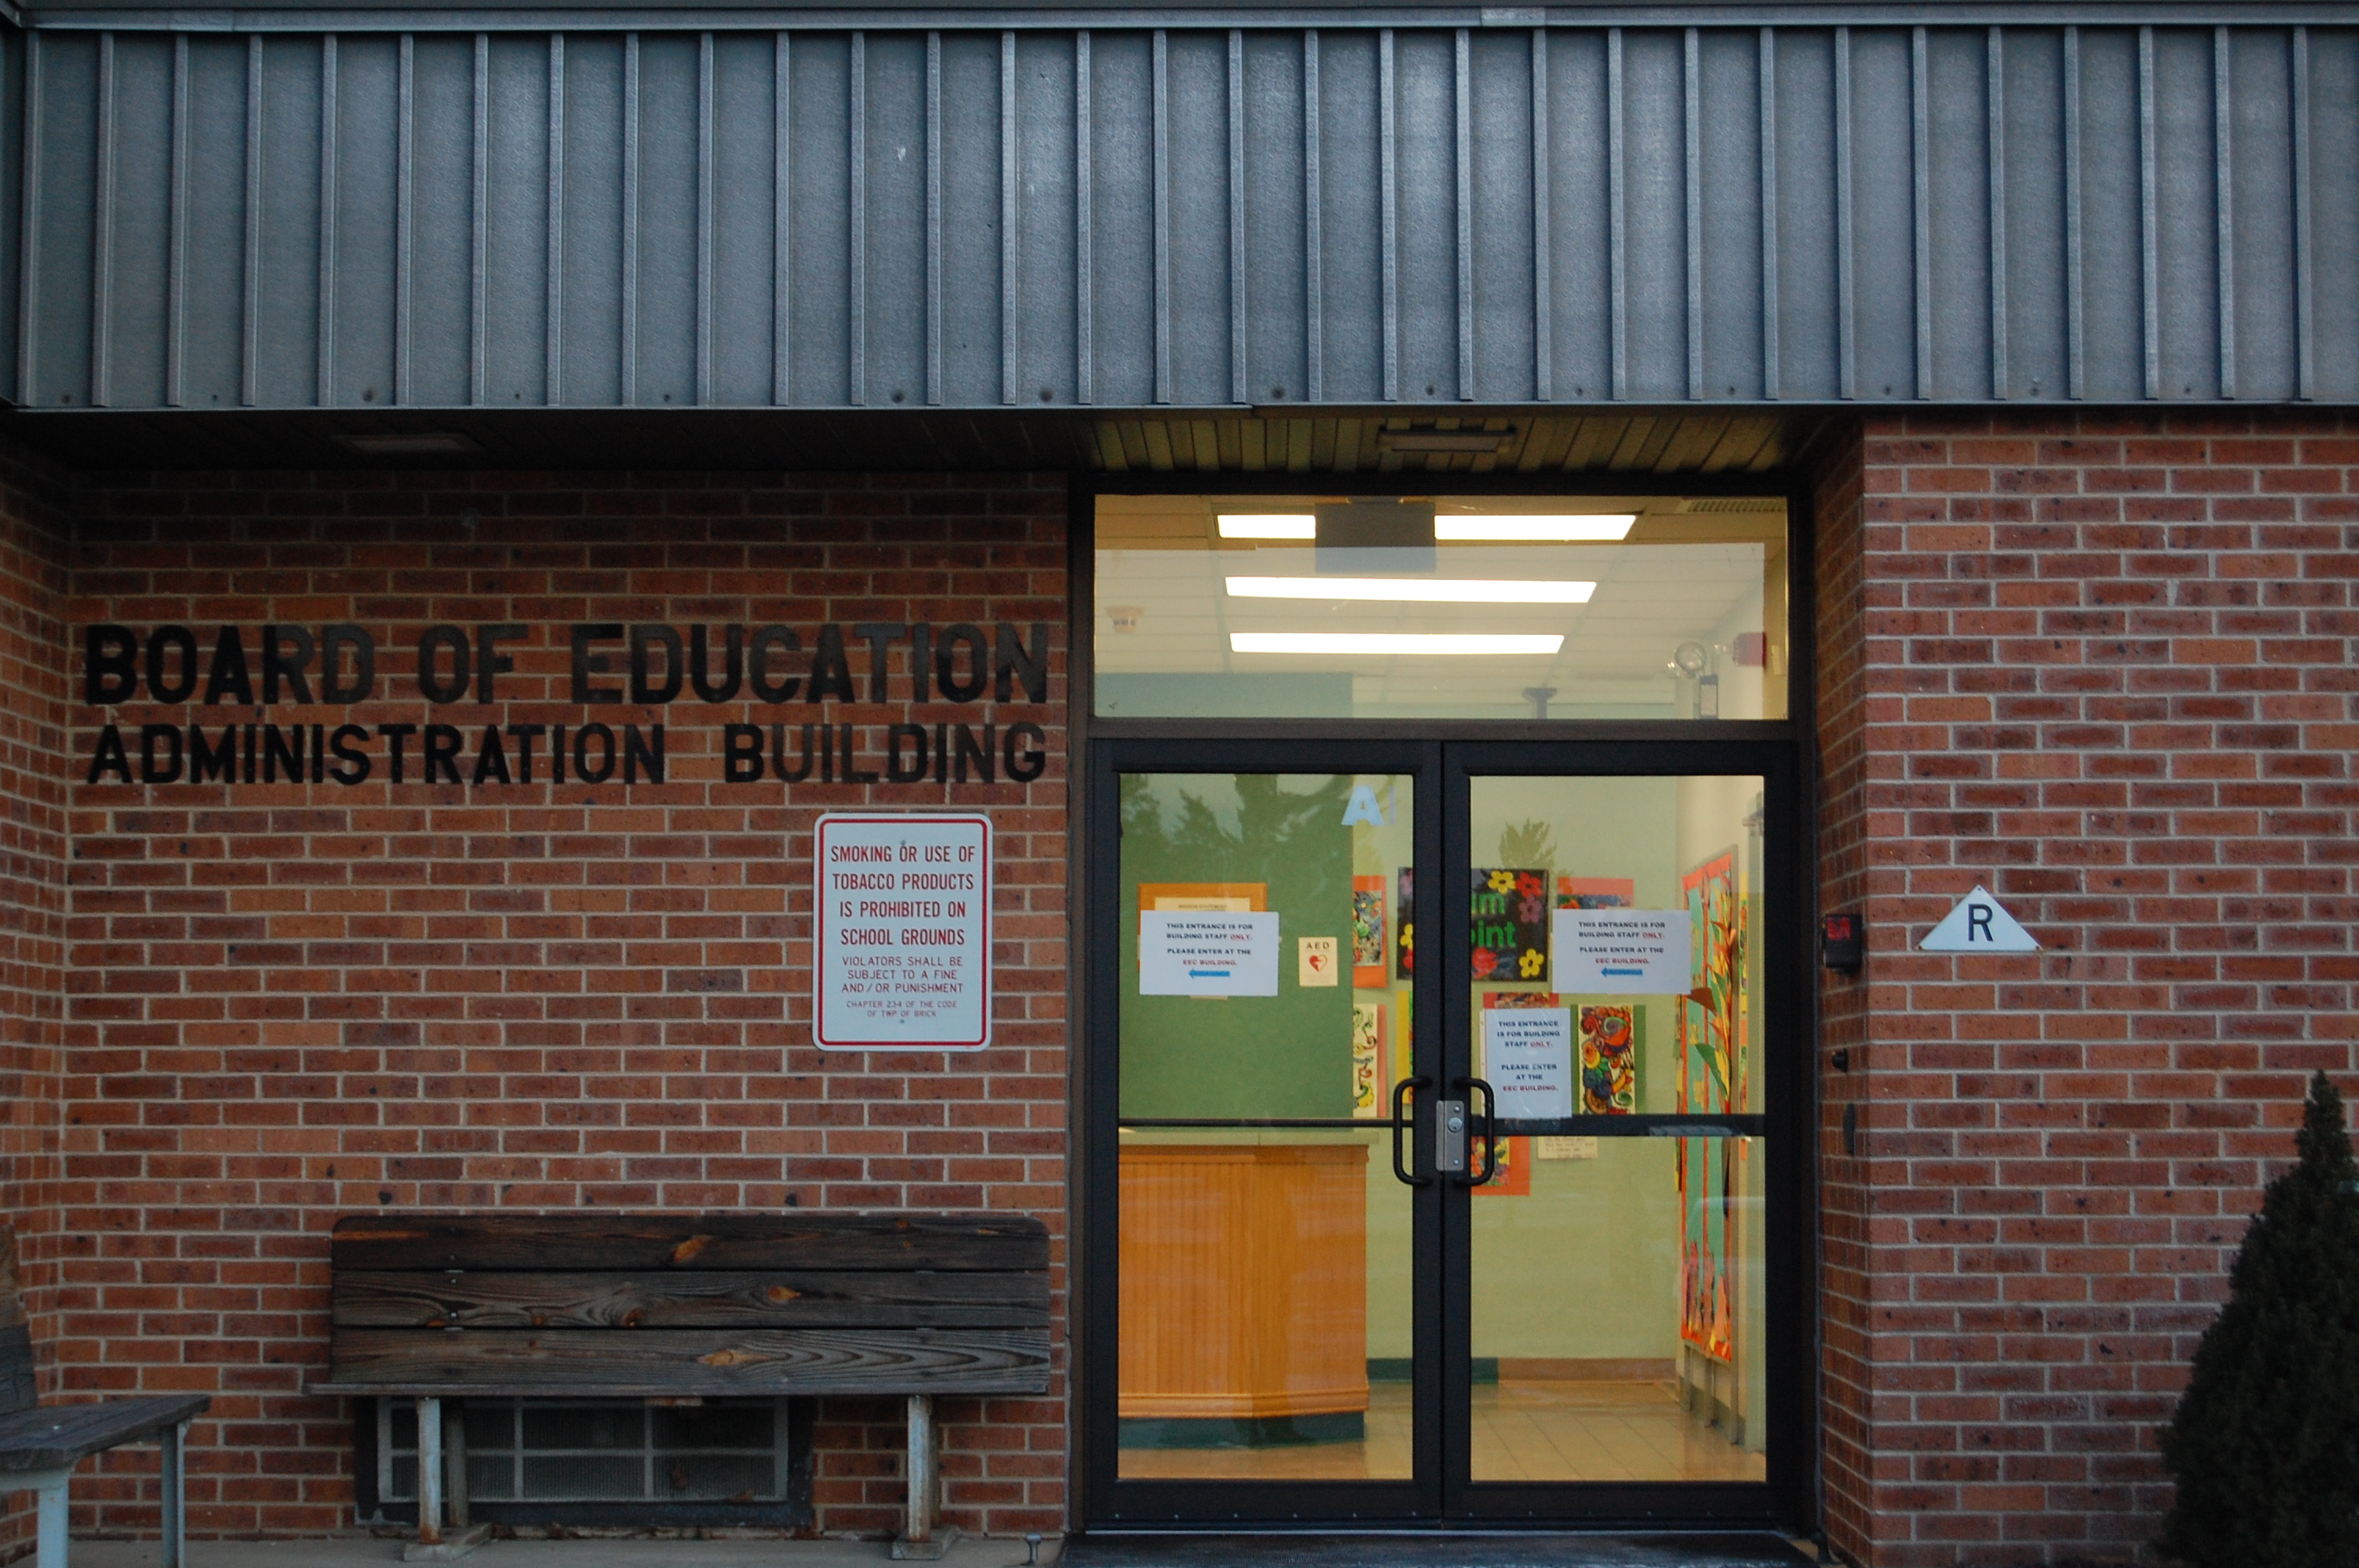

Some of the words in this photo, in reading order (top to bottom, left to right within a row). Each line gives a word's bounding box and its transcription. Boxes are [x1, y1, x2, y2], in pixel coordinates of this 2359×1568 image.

[85, 624, 375, 705] BOARD
[418, 624, 529, 705] OF
[571, 624, 1048, 705] EDUCATION
[88, 722, 665, 785] ADMINISTRATION
[724, 722, 1046, 785] BUILDING
[831, 846, 892, 862] SMOKING
[900, 846, 917, 862] OR
[925, 846, 951, 862] USE
[958, 846, 975, 862] OF
[832, 873, 894, 890] TOBACCO
[902, 873, 974, 890] PRODUCTS
[840, 902, 852, 917] IS
[860, 902, 940, 917] PROHIBITED
[948, 902, 965, 917] ON
[1968, 903, 1994, 942] R
[841, 929, 893, 945] SCHOOL
[901, 929, 965, 945] GROUNDS
[841, 956, 902, 966] VIOLATORS
[907, 956, 943, 966] SHALL
[950, 956, 963, 966] BE
[848, 970, 896, 979] SUBJECT
[902, 970, 915, 979] TO
[921, 970, 929, 979] A
[934, 970, 957, 979] FINE
[895, 983, 963, 993] PUNISHMENT
